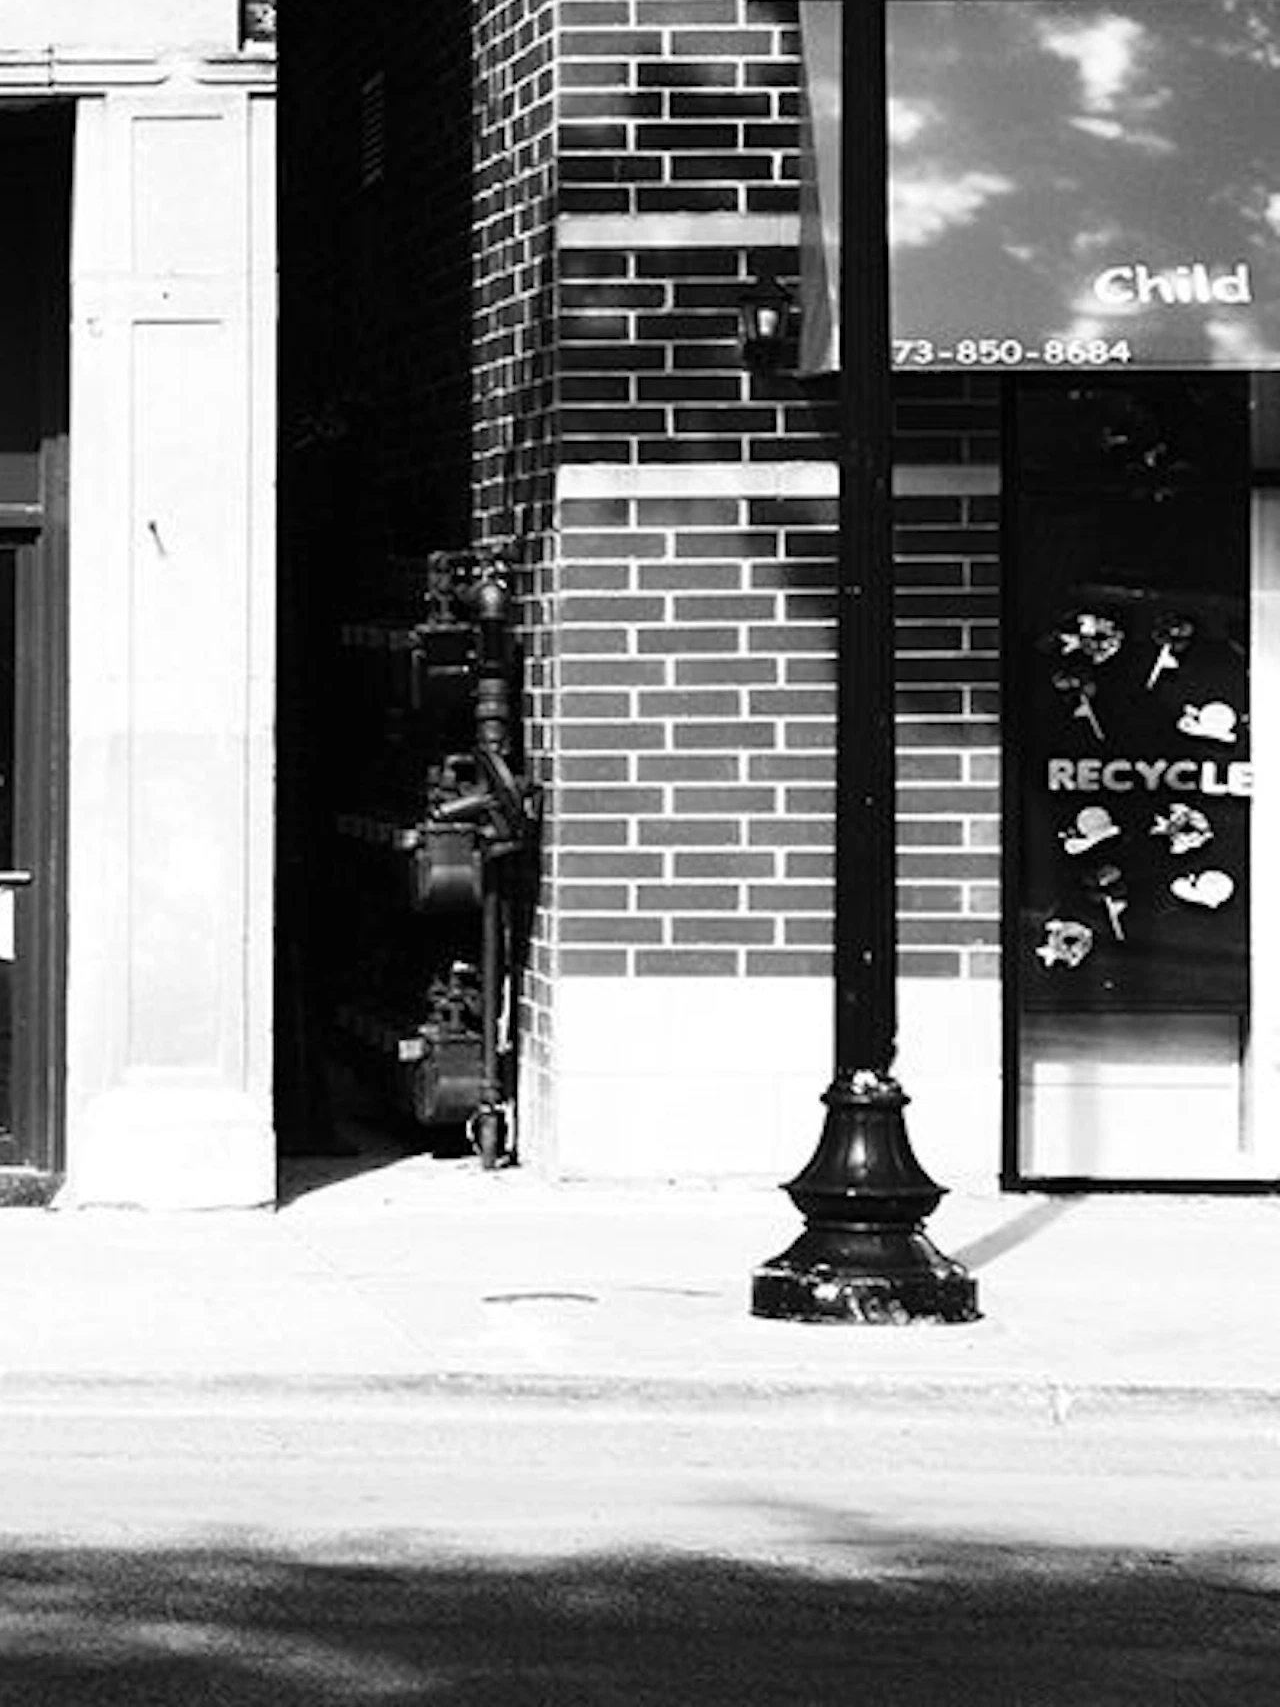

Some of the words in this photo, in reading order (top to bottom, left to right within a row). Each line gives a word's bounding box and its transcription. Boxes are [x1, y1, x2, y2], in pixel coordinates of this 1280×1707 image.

[1091, 263, 1252, 305] Child
[892, 338, 1132, 365] 73-850-8684
[1046, 758, 1253, 797] RECYCLE
